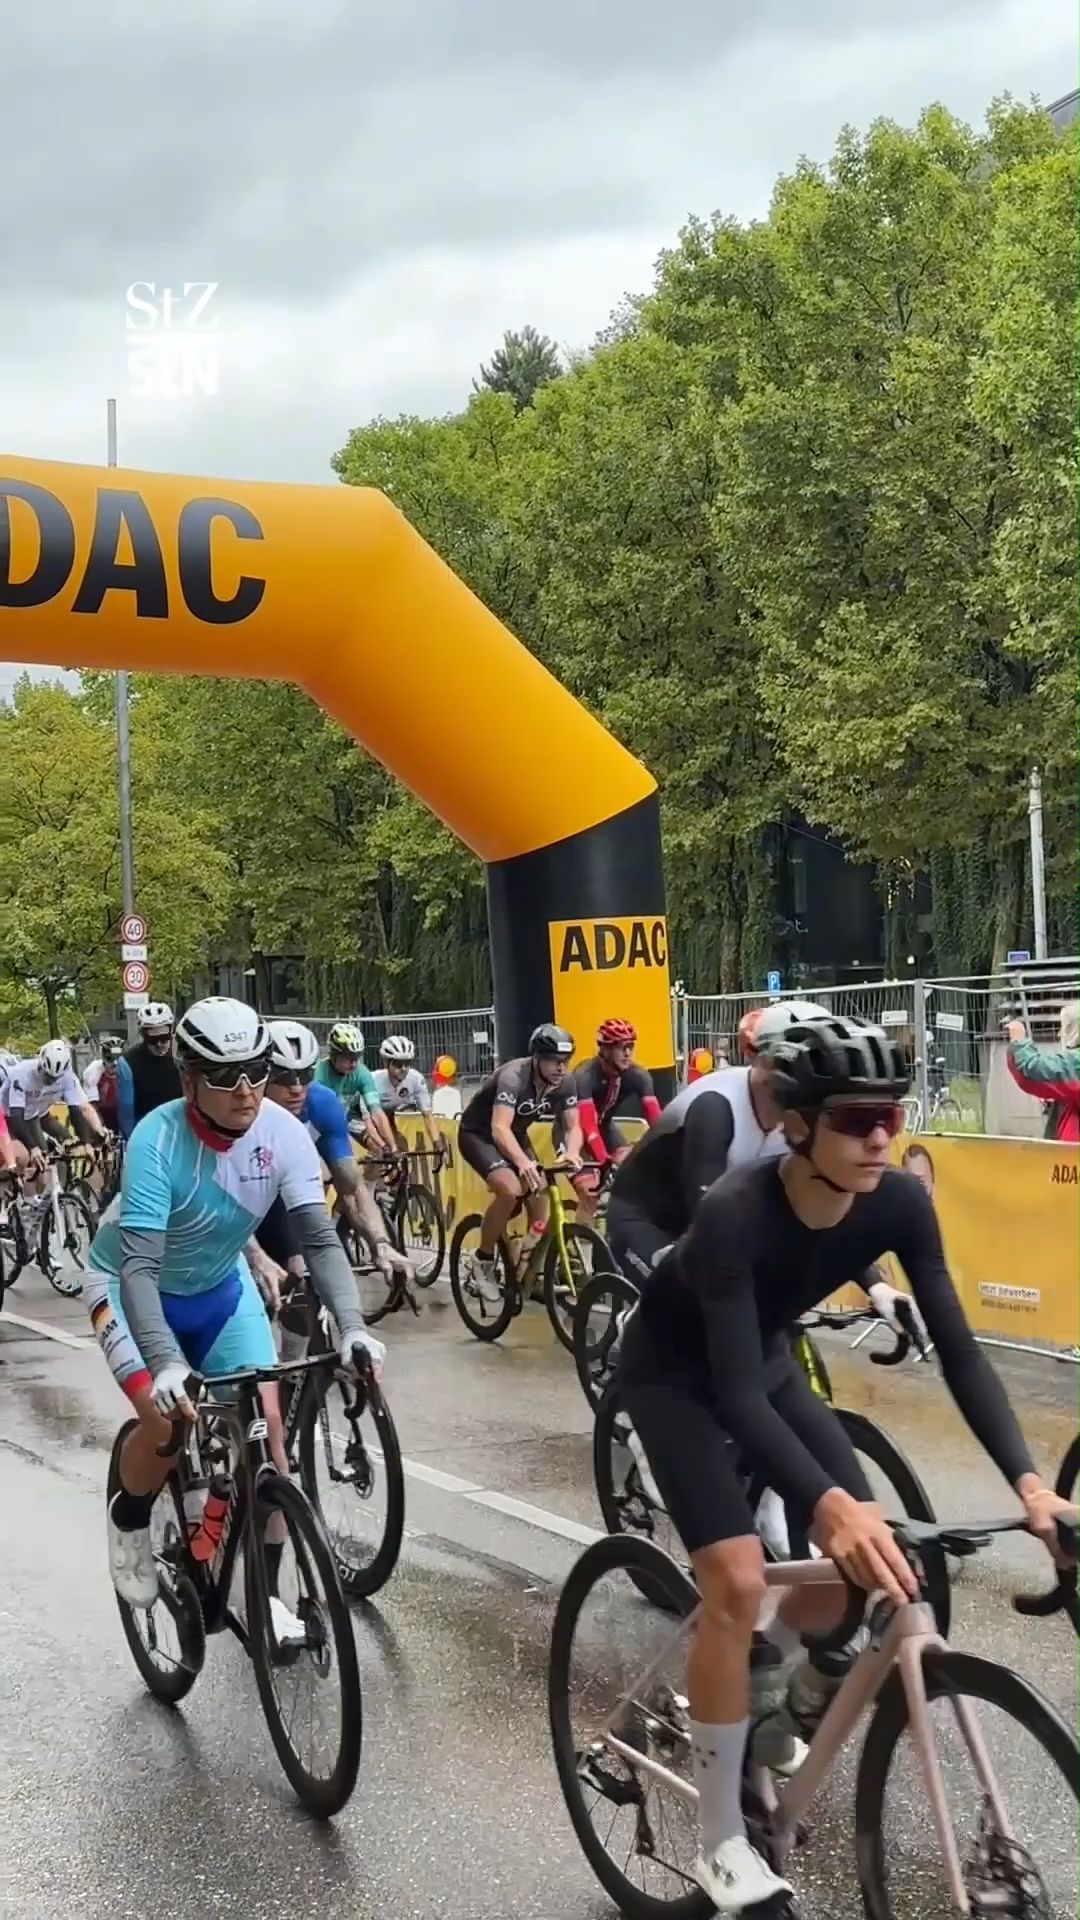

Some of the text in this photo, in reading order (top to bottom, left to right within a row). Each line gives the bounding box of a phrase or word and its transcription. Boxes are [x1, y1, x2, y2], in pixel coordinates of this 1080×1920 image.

[127, 923, 141, 936] 40
[560, 921, 666, 972] ADAC
[129, 970, 142, 983] 30
